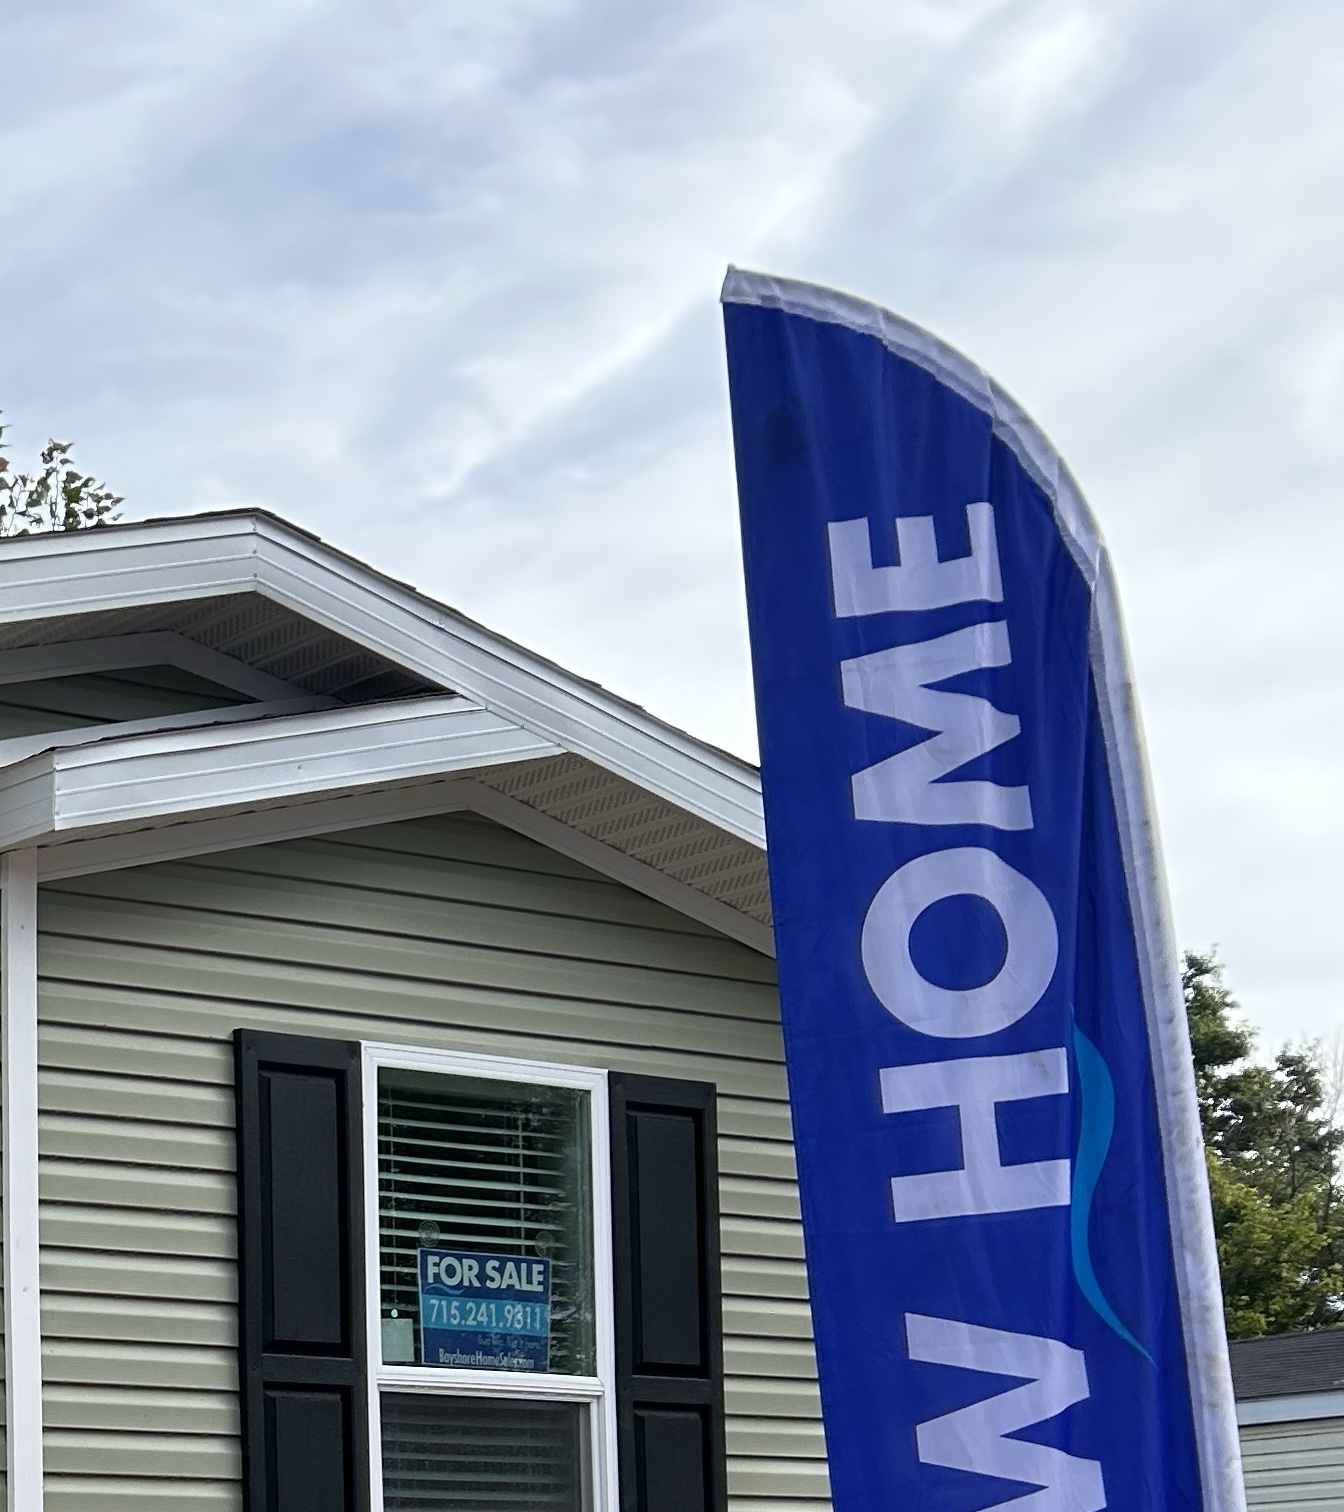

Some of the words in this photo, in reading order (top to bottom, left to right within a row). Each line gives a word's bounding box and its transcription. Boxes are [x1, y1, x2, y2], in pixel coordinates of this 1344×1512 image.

[830, 501, 1072, 1223] HOME
[427, 1255, 481, 1288] FOR
[485, 1259, 544, 1292] SALE
